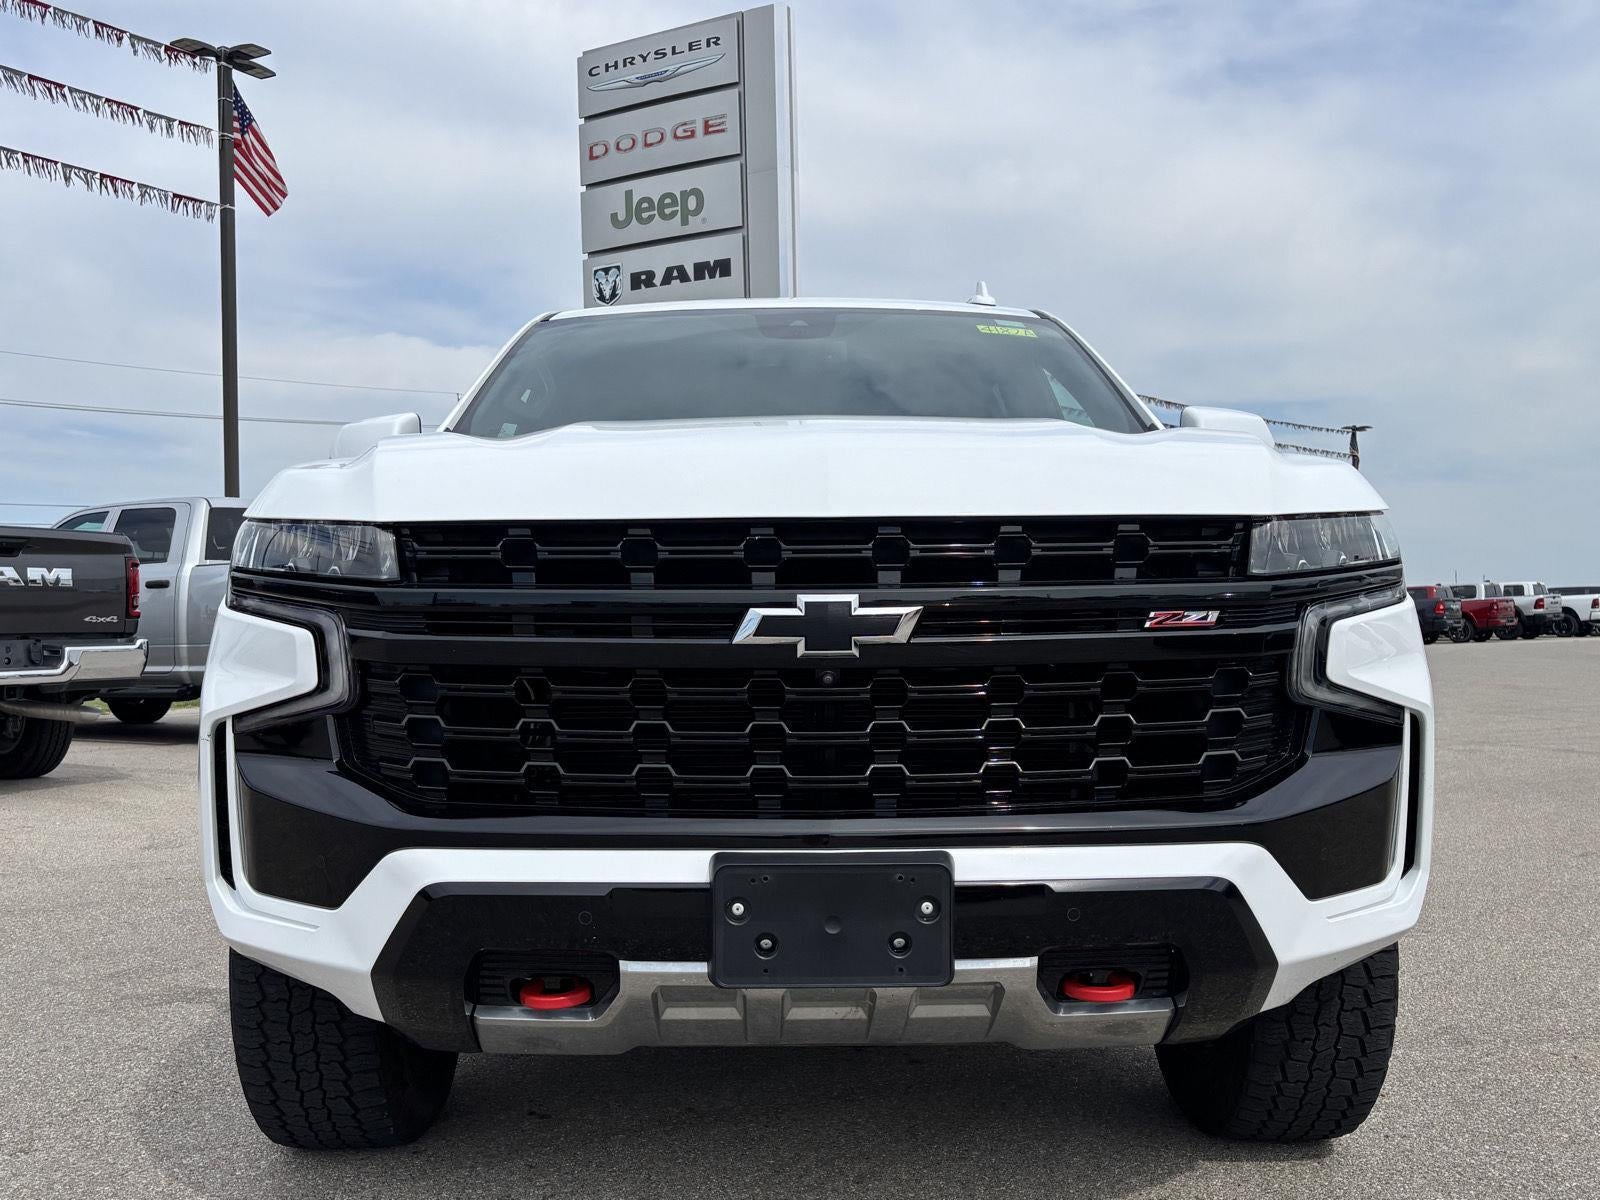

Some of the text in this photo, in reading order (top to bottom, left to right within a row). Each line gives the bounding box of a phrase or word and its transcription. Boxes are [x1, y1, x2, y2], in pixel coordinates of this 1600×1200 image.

[588, 36, 722, 77] CHRYSLER
[588, 114, 728, 161] DODGE
[610, 187, 705, 229] Jeep
[629, 257, 732, 291] RAM
[0, 566, 73, 587] AM
[1144, 610, 1220, 628] Z71
